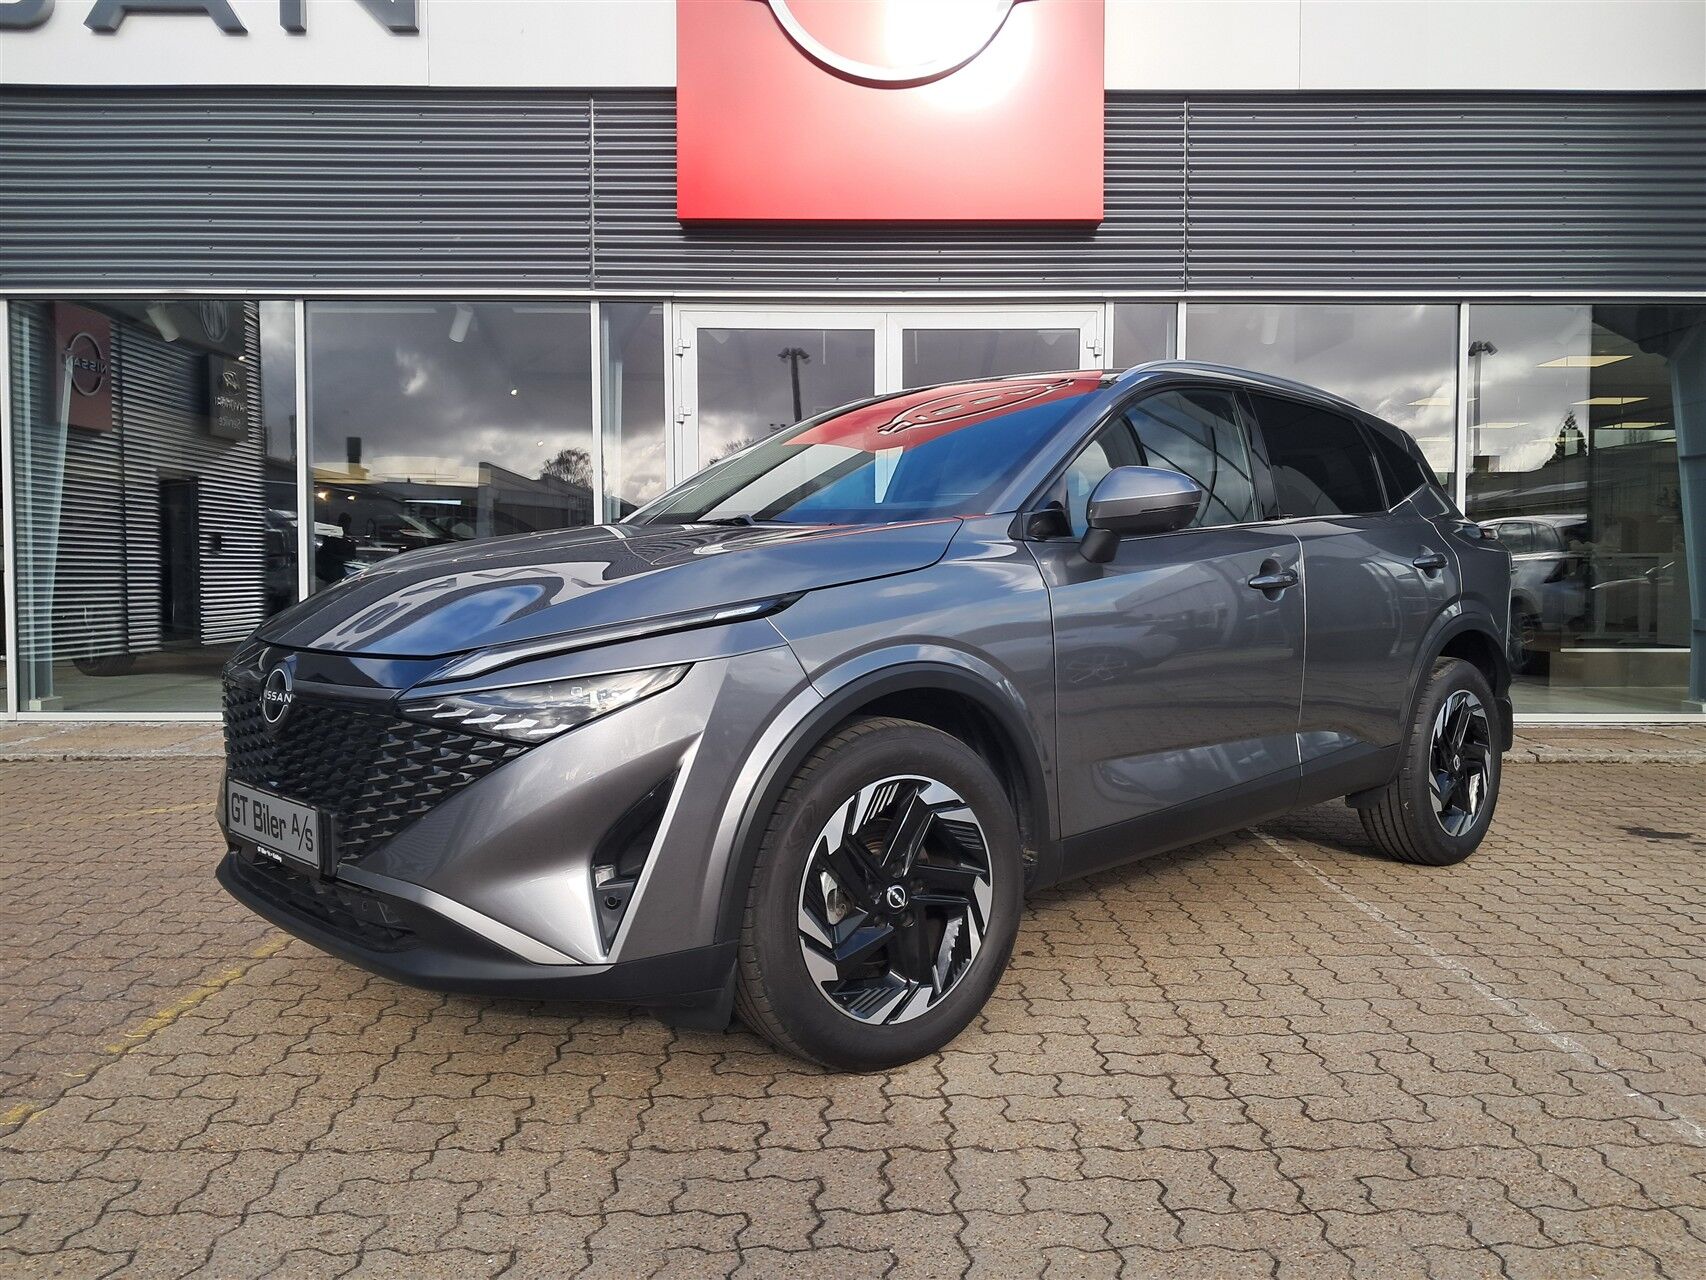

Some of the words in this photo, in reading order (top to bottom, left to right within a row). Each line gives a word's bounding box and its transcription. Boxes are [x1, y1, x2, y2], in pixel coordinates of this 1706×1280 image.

[264, 690, 292, 703] SSAN
[231, 792, 248, 826] GT
[253, 800, 287, 841] Biler
